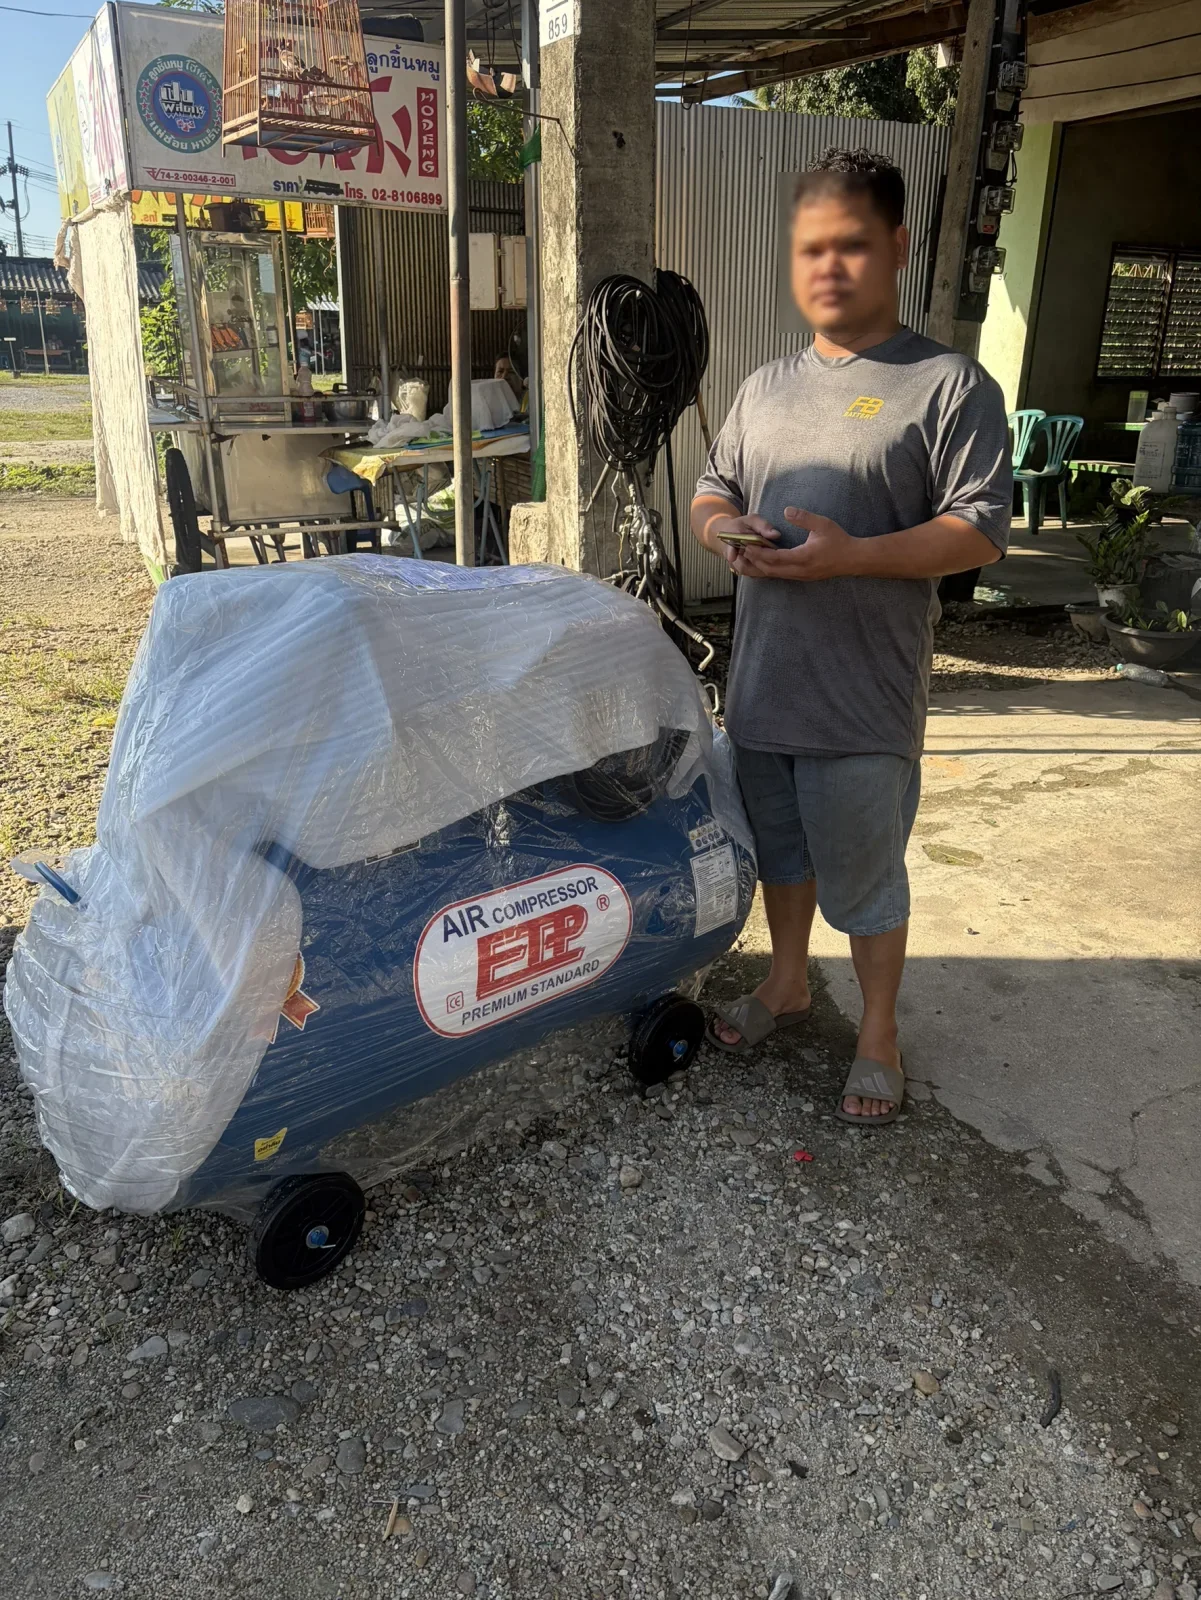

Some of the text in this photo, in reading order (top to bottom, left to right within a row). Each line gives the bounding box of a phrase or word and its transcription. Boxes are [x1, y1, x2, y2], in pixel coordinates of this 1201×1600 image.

[548, 13, 568, 40] 859
[344, 182, 367, 200] โทร.
[372, 188, 443, 206] 02-8106899
[443, 876, 598, 943] AIR COMPRESSOR
[462, 959, 600, 1025] PREMIUM STANDARD
